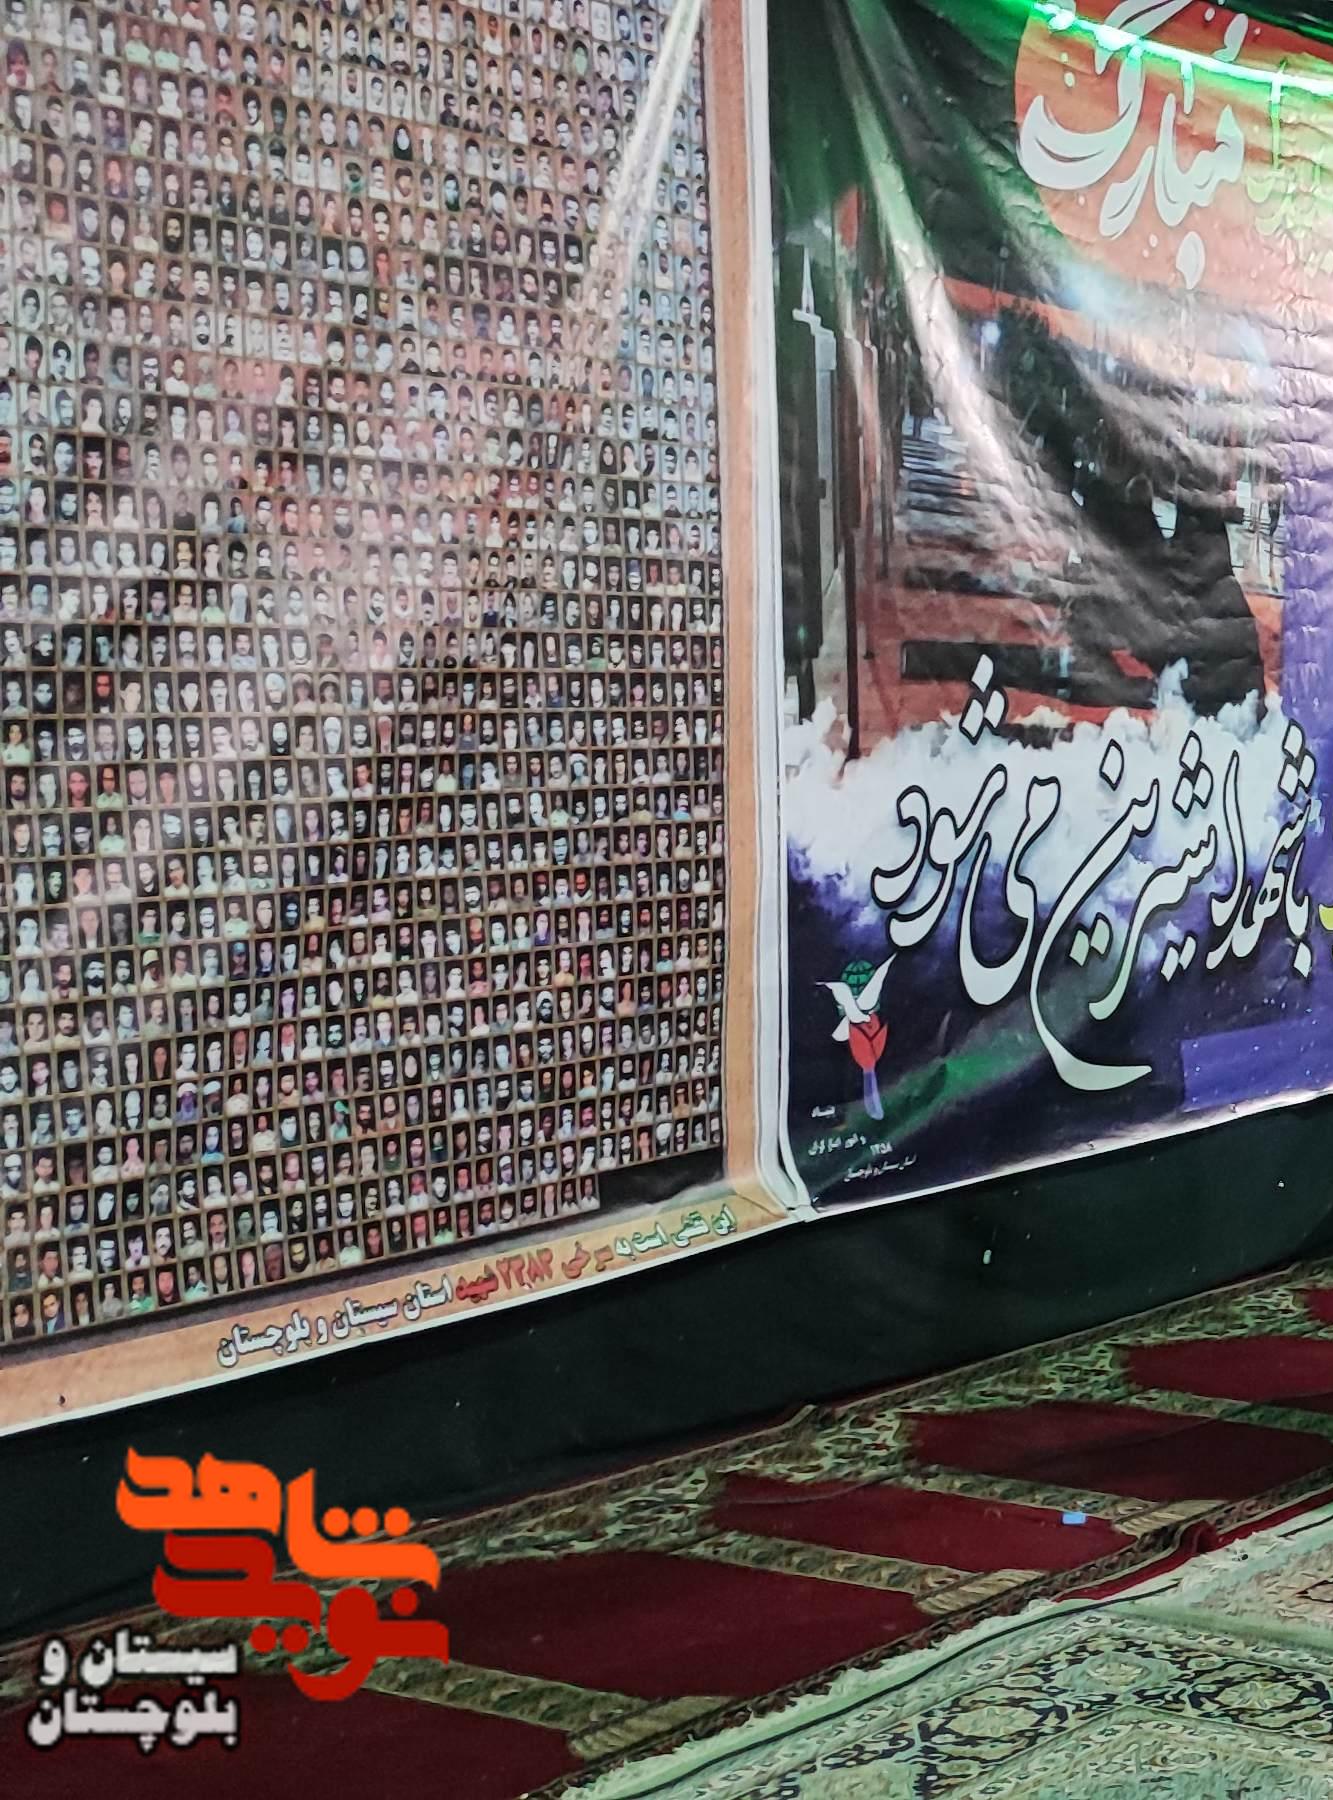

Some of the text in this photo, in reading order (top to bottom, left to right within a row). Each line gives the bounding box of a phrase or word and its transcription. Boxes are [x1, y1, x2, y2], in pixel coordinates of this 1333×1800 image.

[870, 652, 1008, 948] شود
[1205, 720, 1318, 971] شهدا
[1028, 730, 1218, 1092] شیرین
[632, 1222, 669, 1252] است
[712, 1203, 738, 1236] این
[614, 1236, 635, 1261] به
[332, 1297, 399, 1339] سیستان
[402, 1274, 454, 1321] استان
[217, 1309, 313, 1368] بلوچستان
[316, 1316, 329, 1345] و
